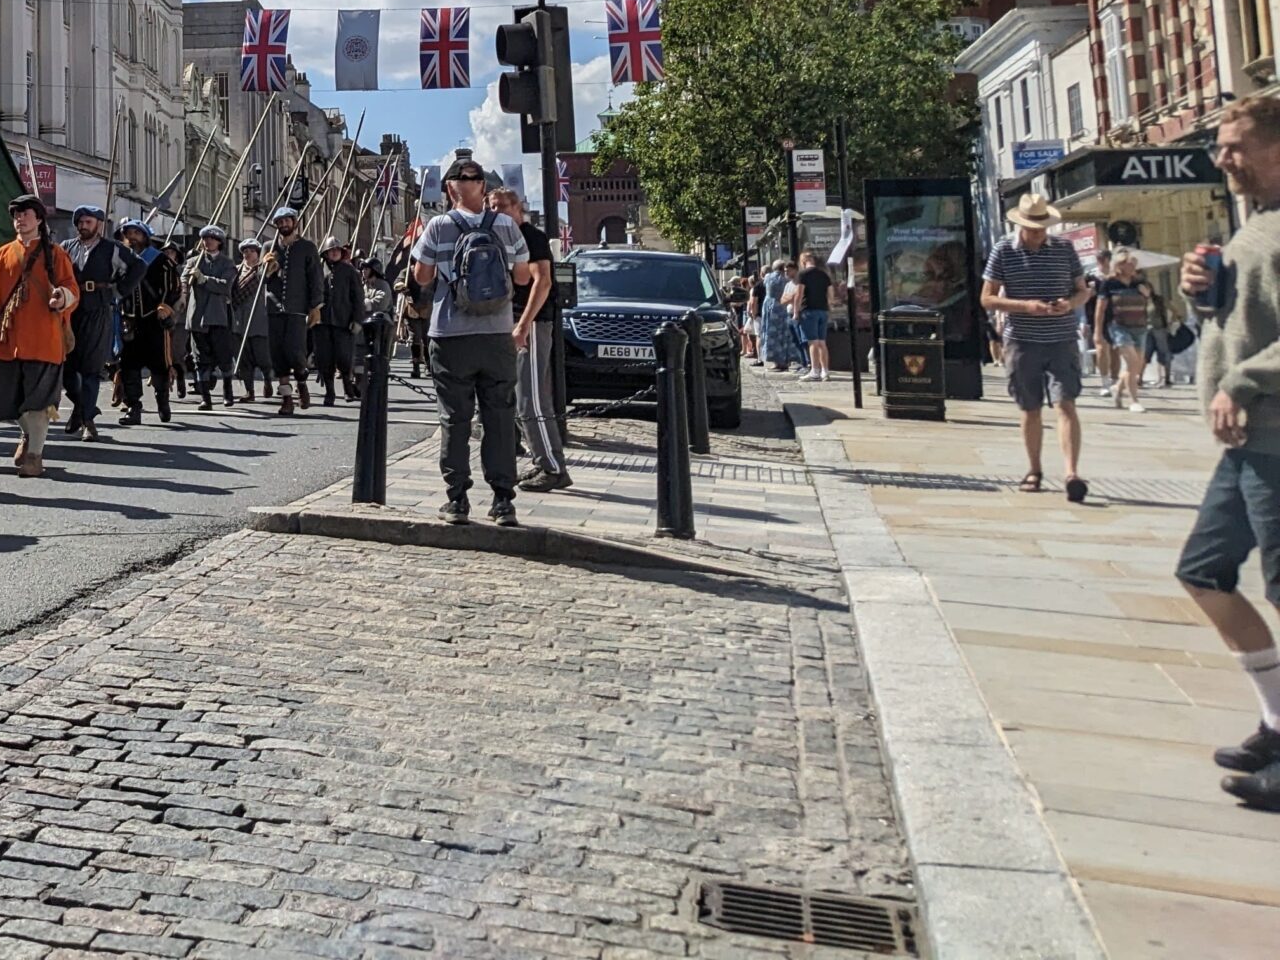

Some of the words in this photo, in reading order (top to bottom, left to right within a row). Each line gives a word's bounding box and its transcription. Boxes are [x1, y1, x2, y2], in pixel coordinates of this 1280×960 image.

[1121, 155, 1197, 179] ATIK
[602, 346, 631, 357] AE68
[633, 347, 655, 358] VTA
